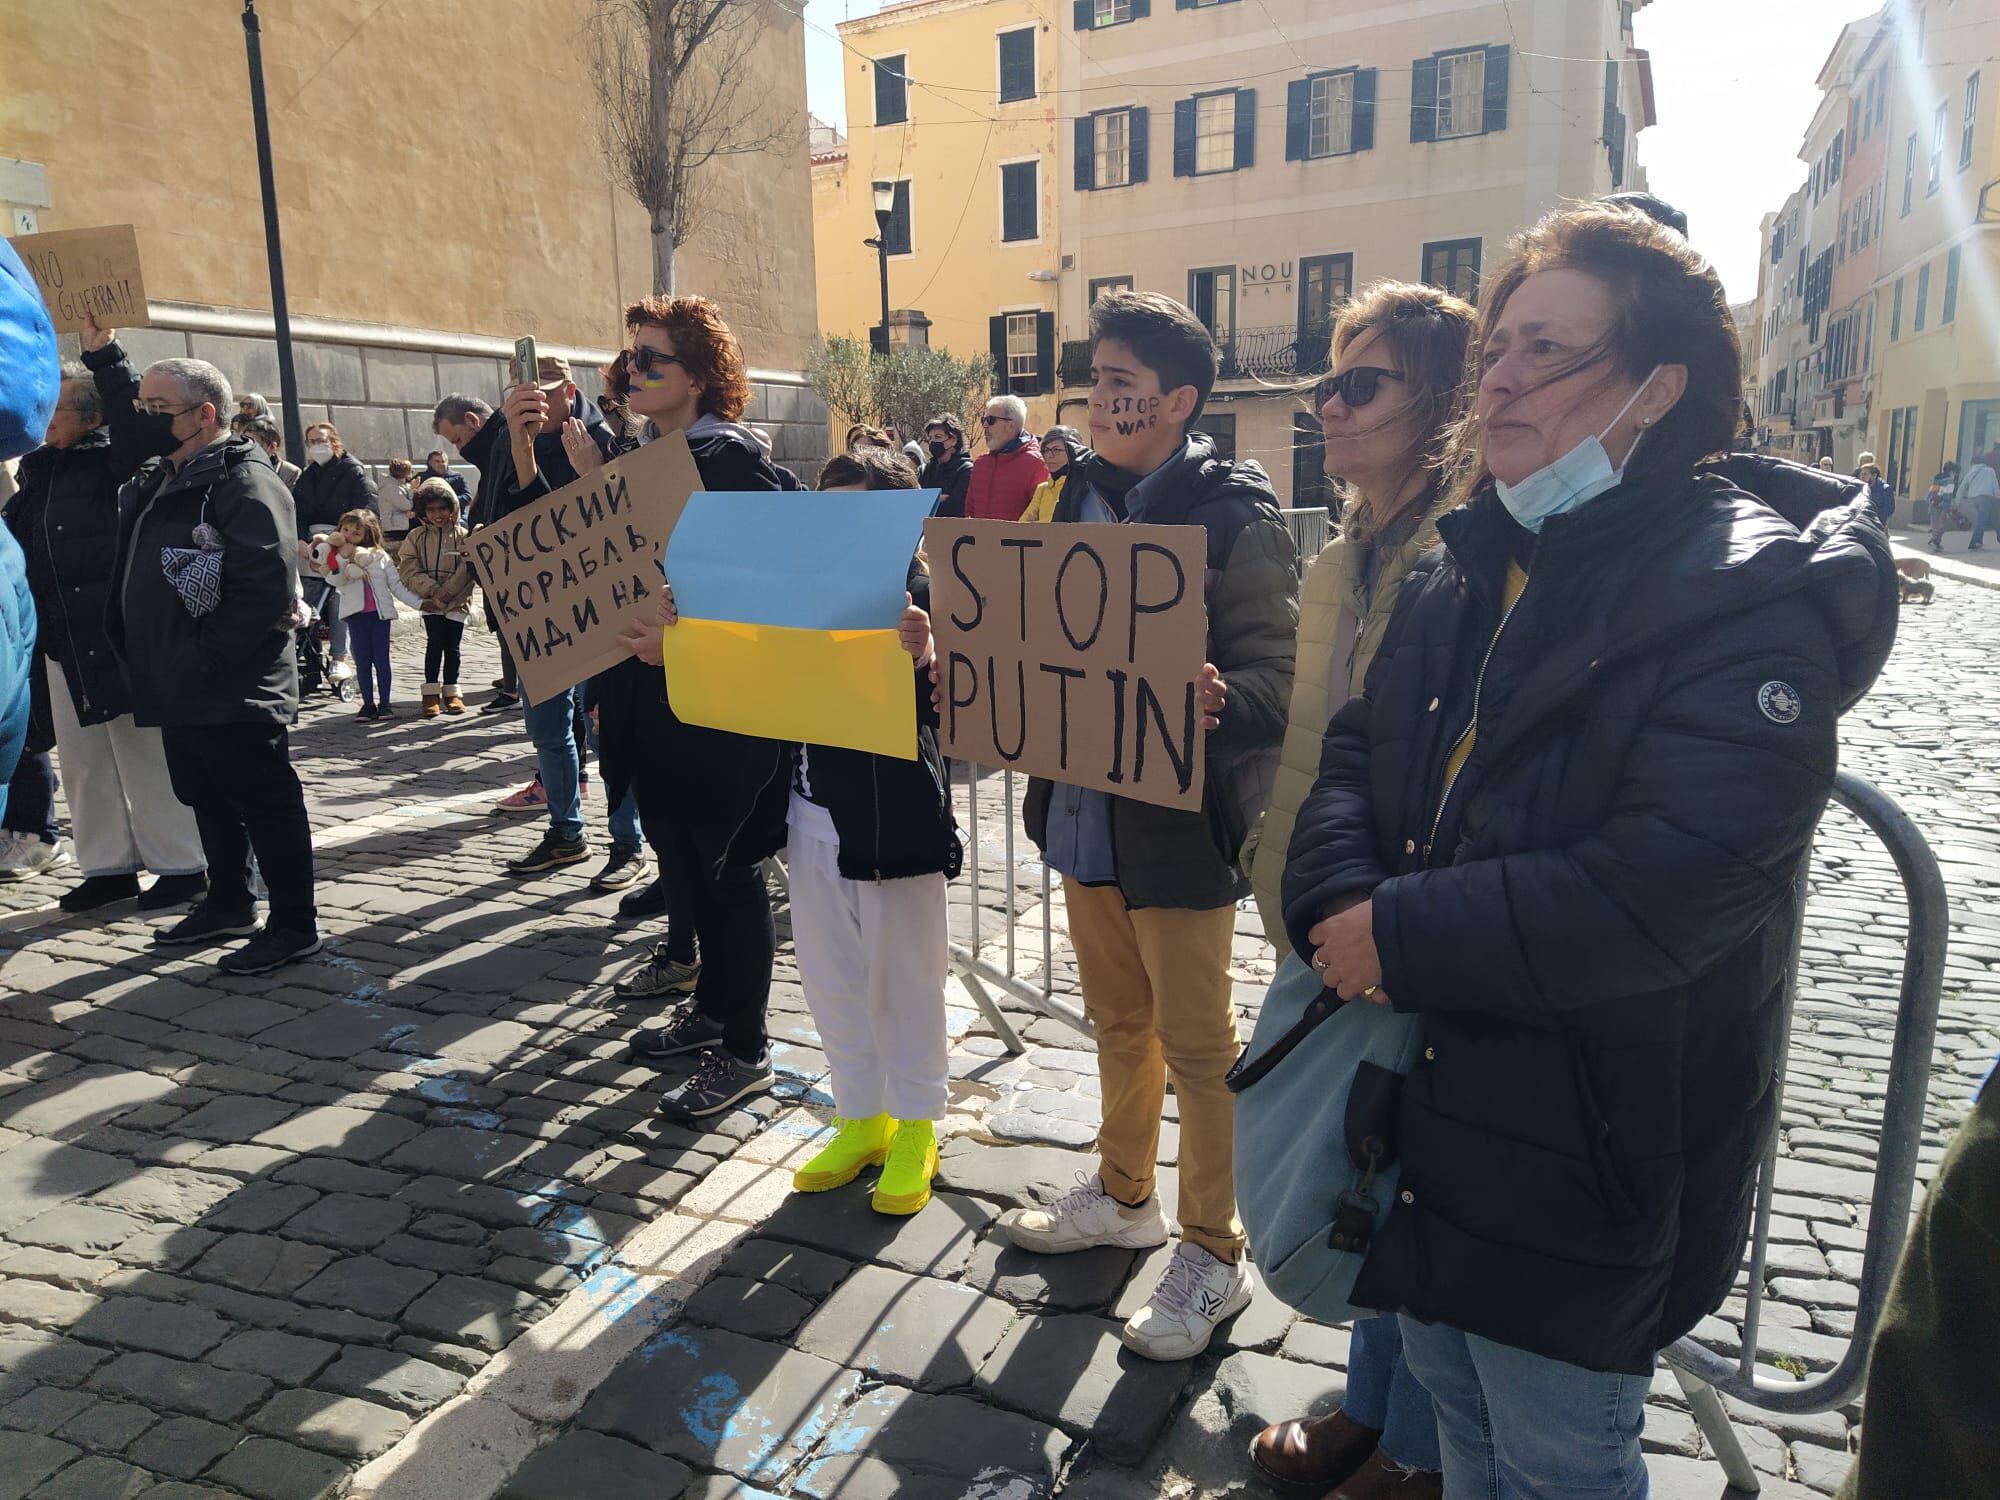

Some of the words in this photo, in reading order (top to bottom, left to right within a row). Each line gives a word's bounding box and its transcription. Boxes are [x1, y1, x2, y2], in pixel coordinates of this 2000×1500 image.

[28, 251, 64, 289] NO
[1242, 261, 1292, 283] NOU
[1111, 396, 1160, 415] STOP
[1116, 415, 1158, 436] WAR
[950, 535, 1186, 663] STOP
[516, 597, 600, 662] ИДИ
[612, 575, 650, 610] НА
[949, 651, 1195, 795] PUTIN
